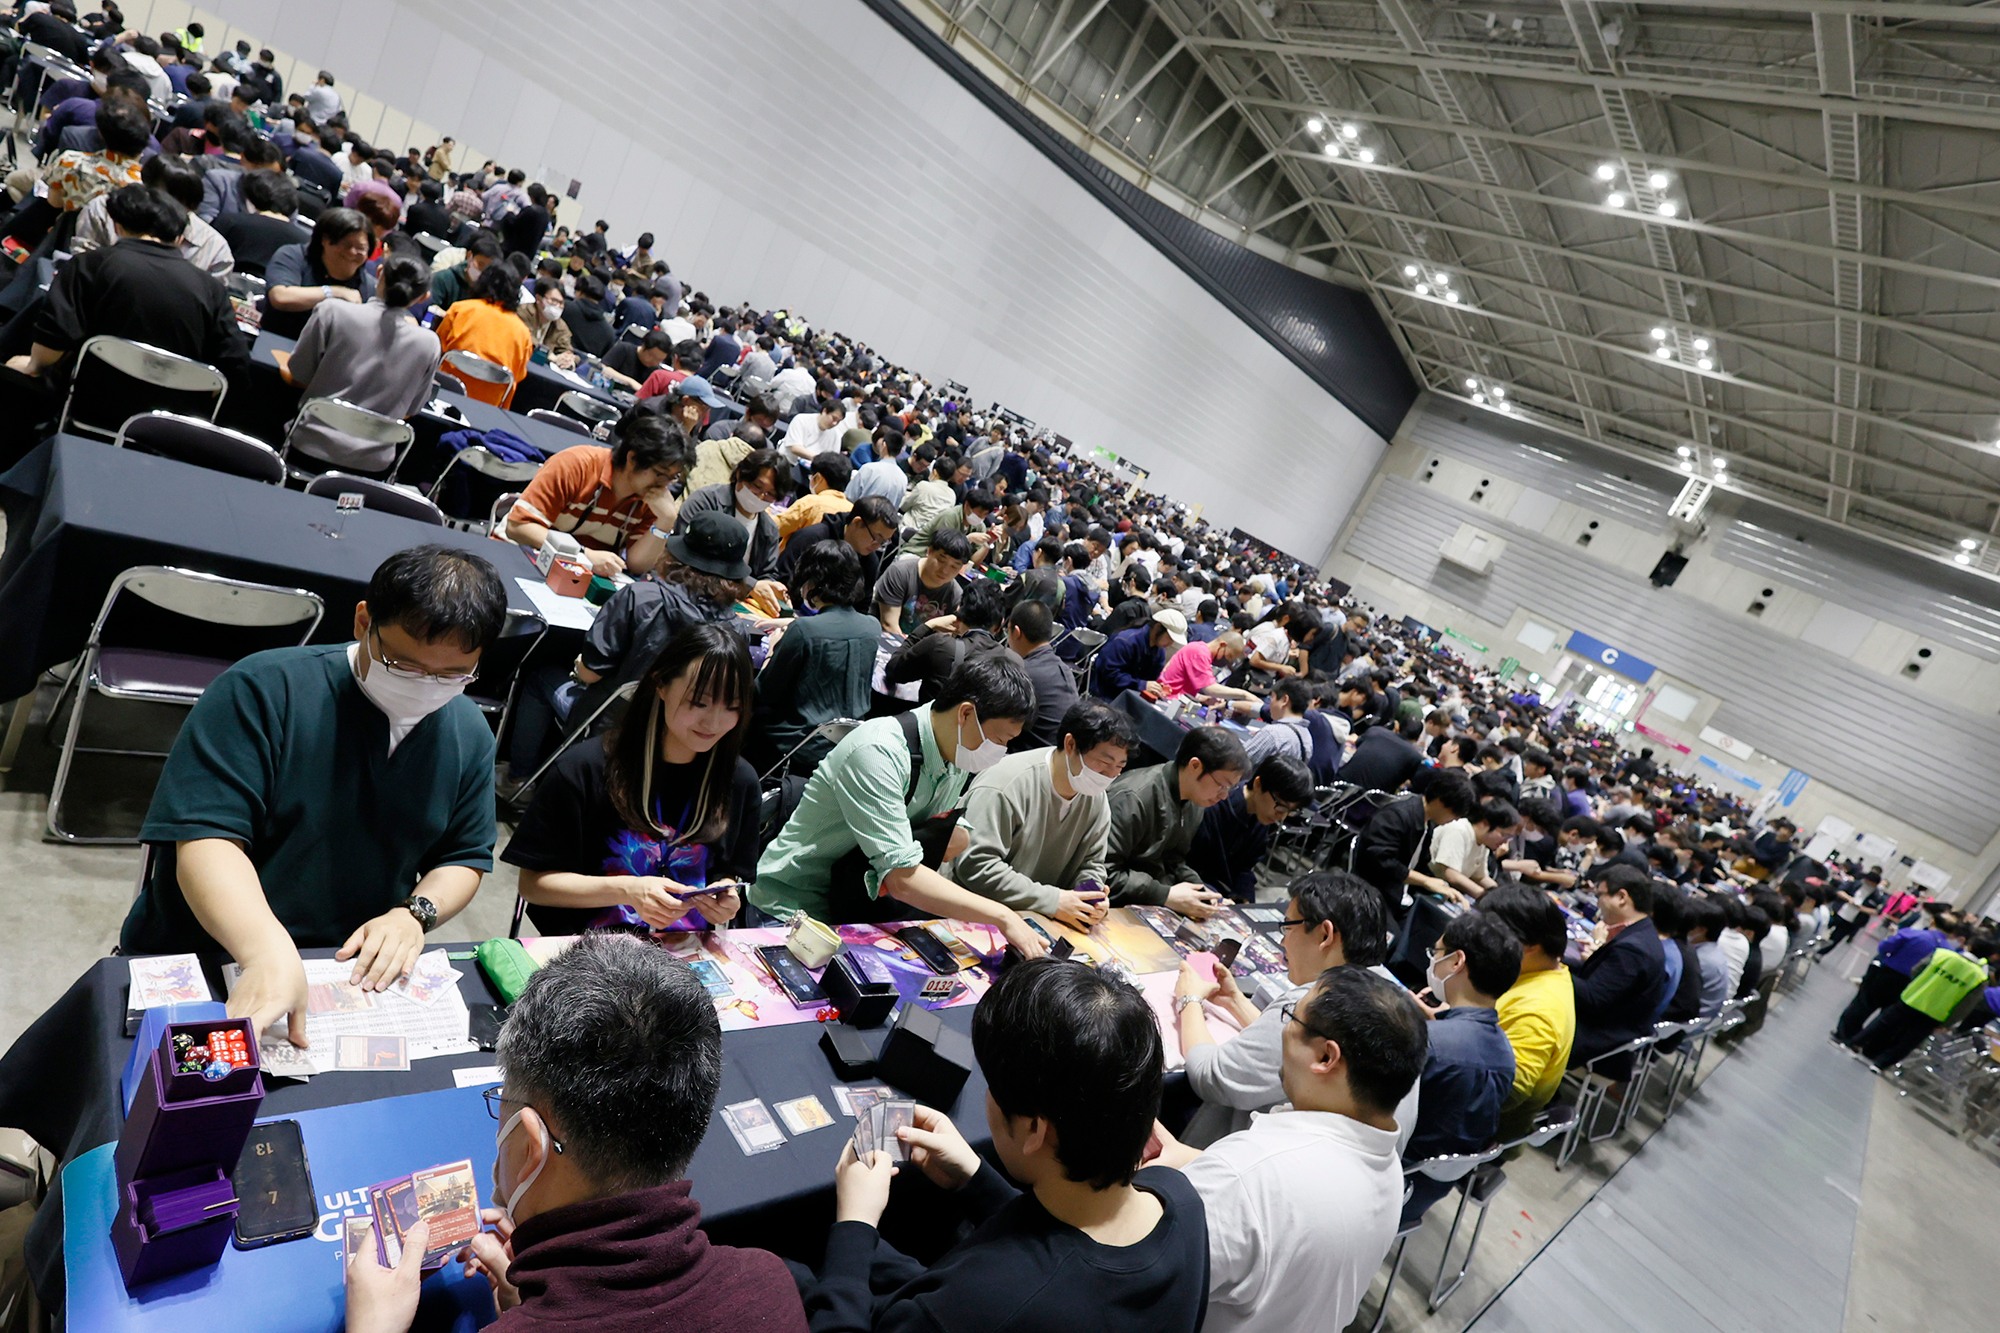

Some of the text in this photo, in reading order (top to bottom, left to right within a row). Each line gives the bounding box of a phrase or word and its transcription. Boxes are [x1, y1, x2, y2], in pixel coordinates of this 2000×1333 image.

[1601, 648, 1619, 665] C
[926, 980, 954, 991] 0132
[255, 1142, 274, 1156] 13
[268, 1190, 278, 1204] 7
[323, 1186, 369, 1210] ULT
